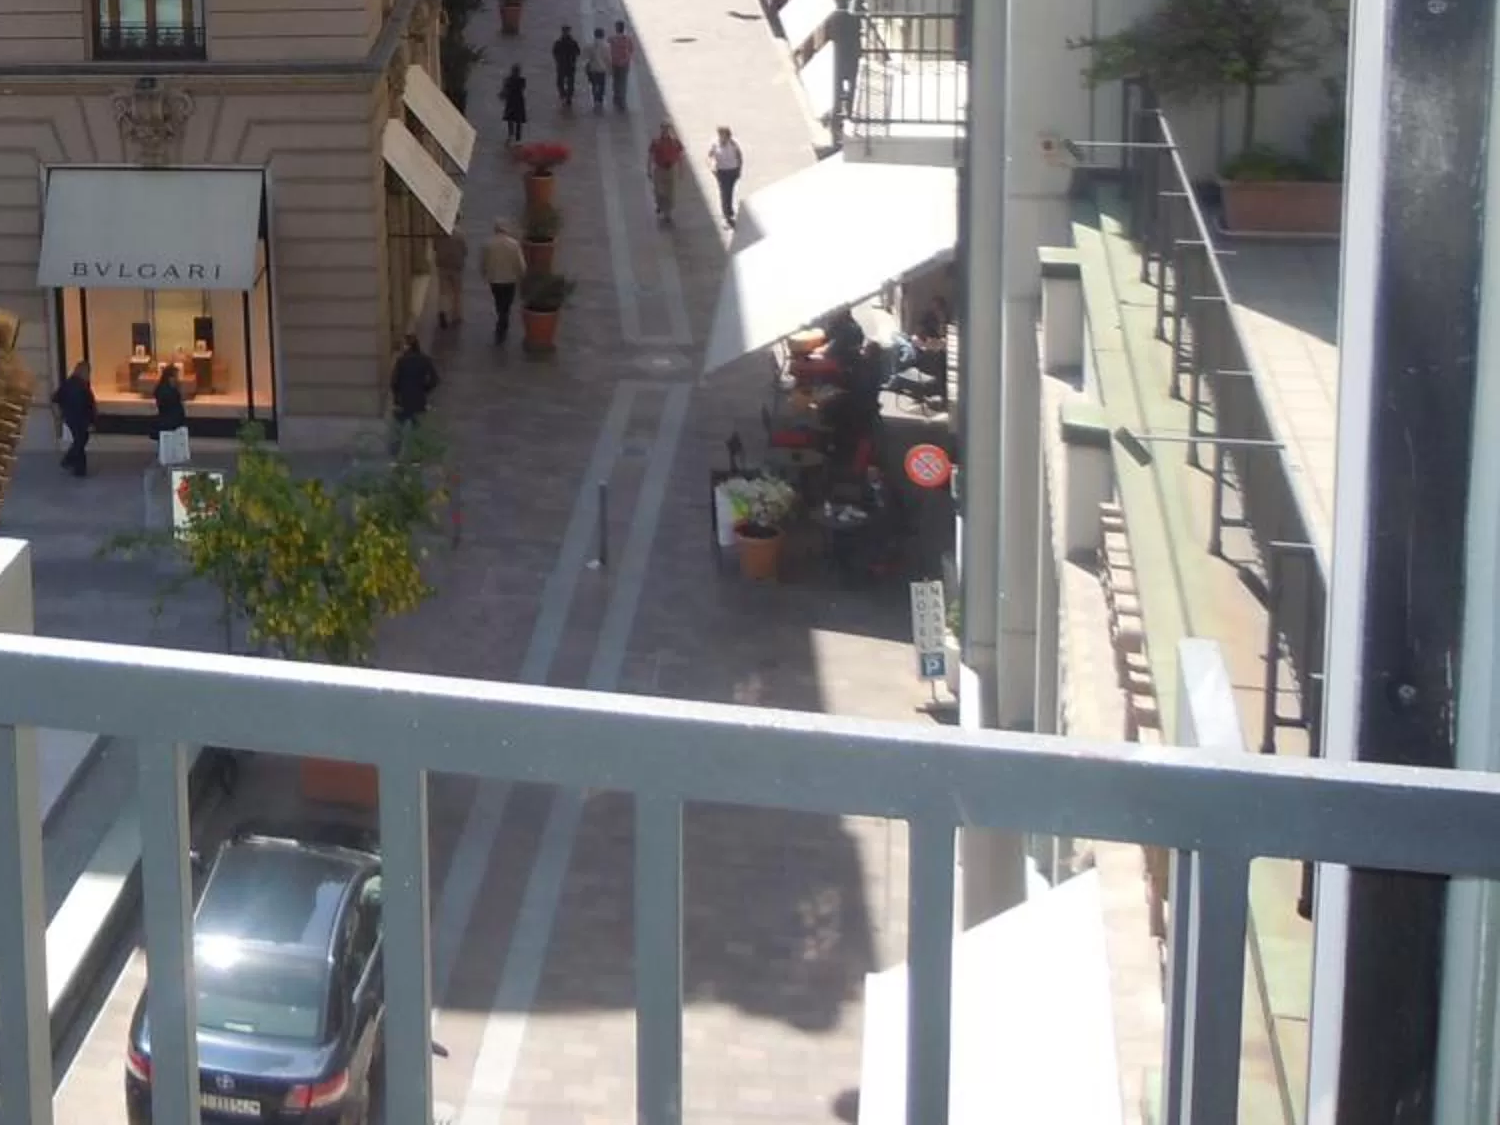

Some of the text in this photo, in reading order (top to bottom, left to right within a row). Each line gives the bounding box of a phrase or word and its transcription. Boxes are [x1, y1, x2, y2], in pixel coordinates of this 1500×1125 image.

[72, 262, 222, 280] BVLGARI
[915, 587, 927, 650] HOTEL
[926, 658, 941, 675] P
